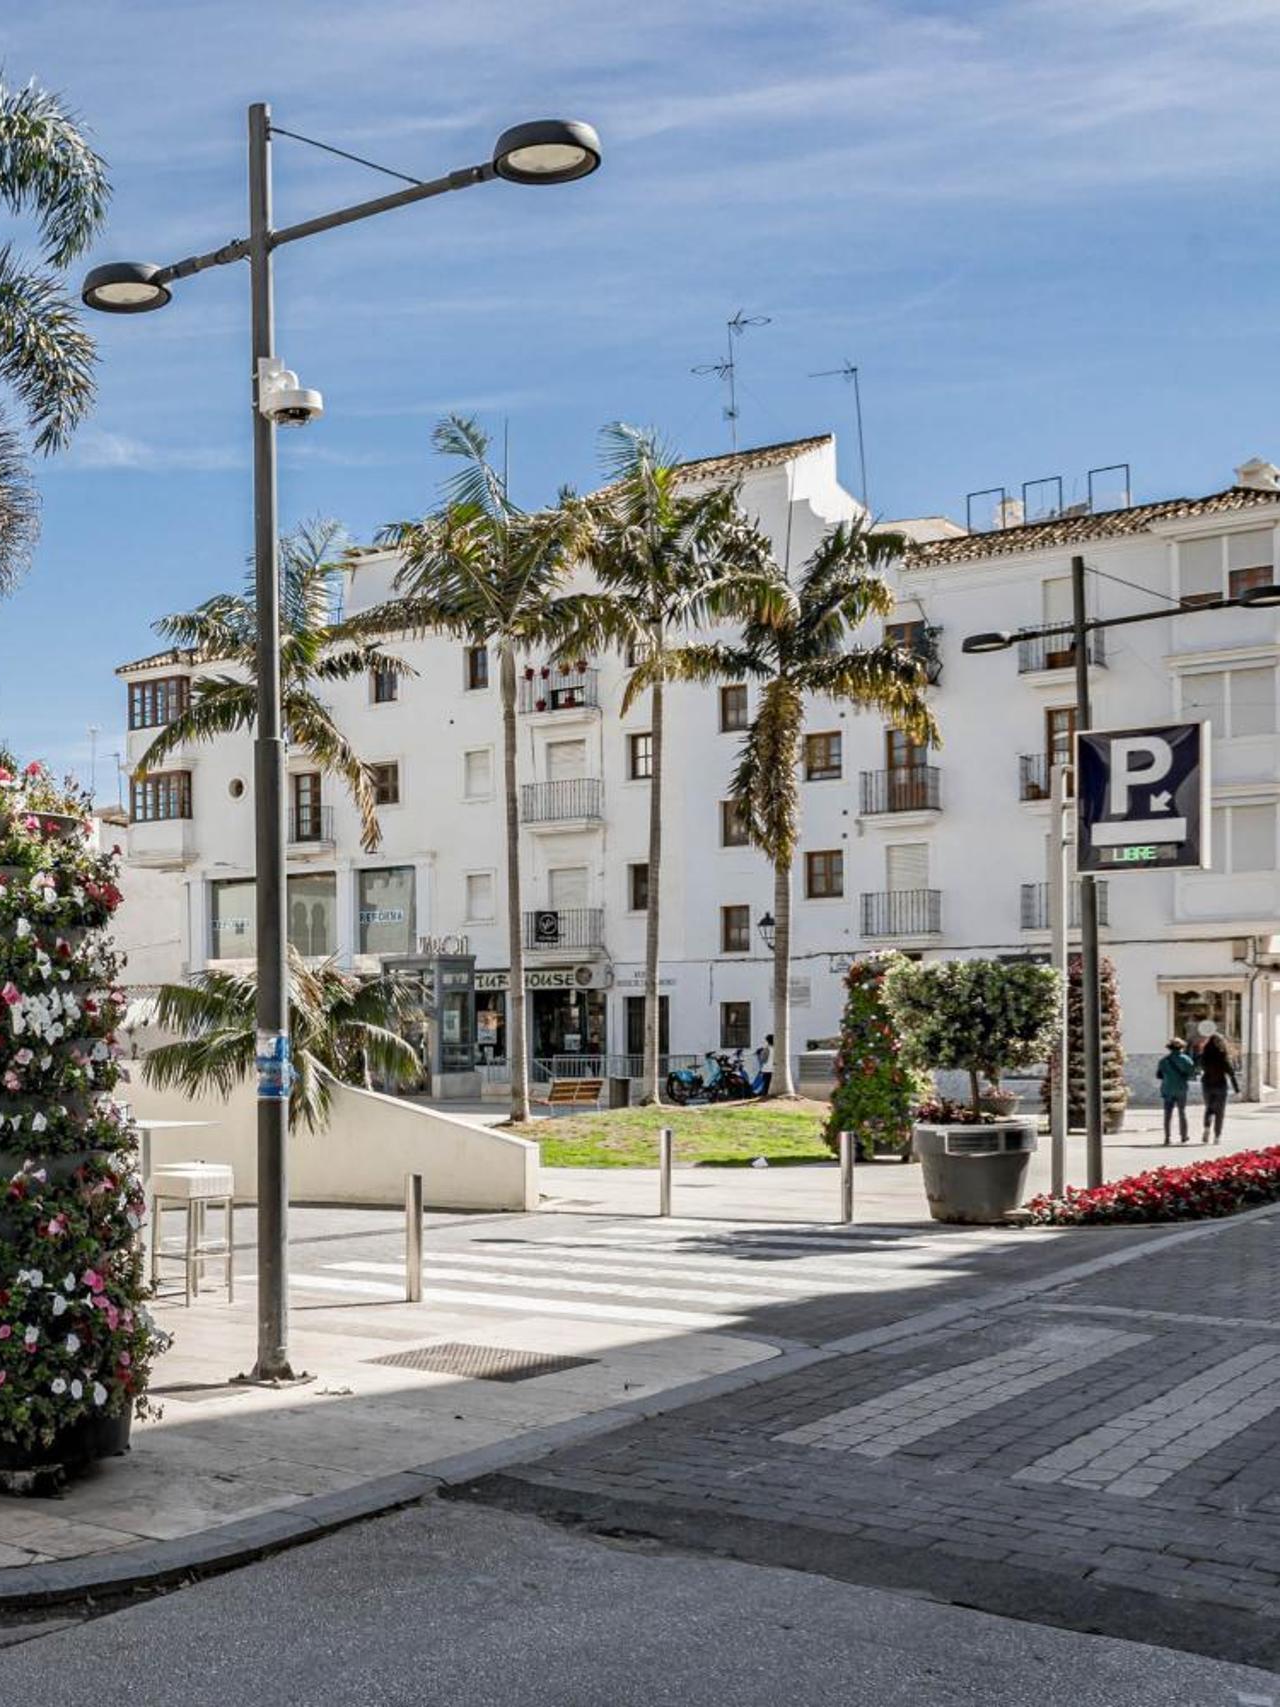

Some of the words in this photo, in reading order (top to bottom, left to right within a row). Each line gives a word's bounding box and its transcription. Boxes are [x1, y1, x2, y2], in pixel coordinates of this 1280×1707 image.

[1110, 736, 1173, 815] P
[1112, 846, 1158, 862] LIBRE
[360, 910, 402, 923] REFORMA
